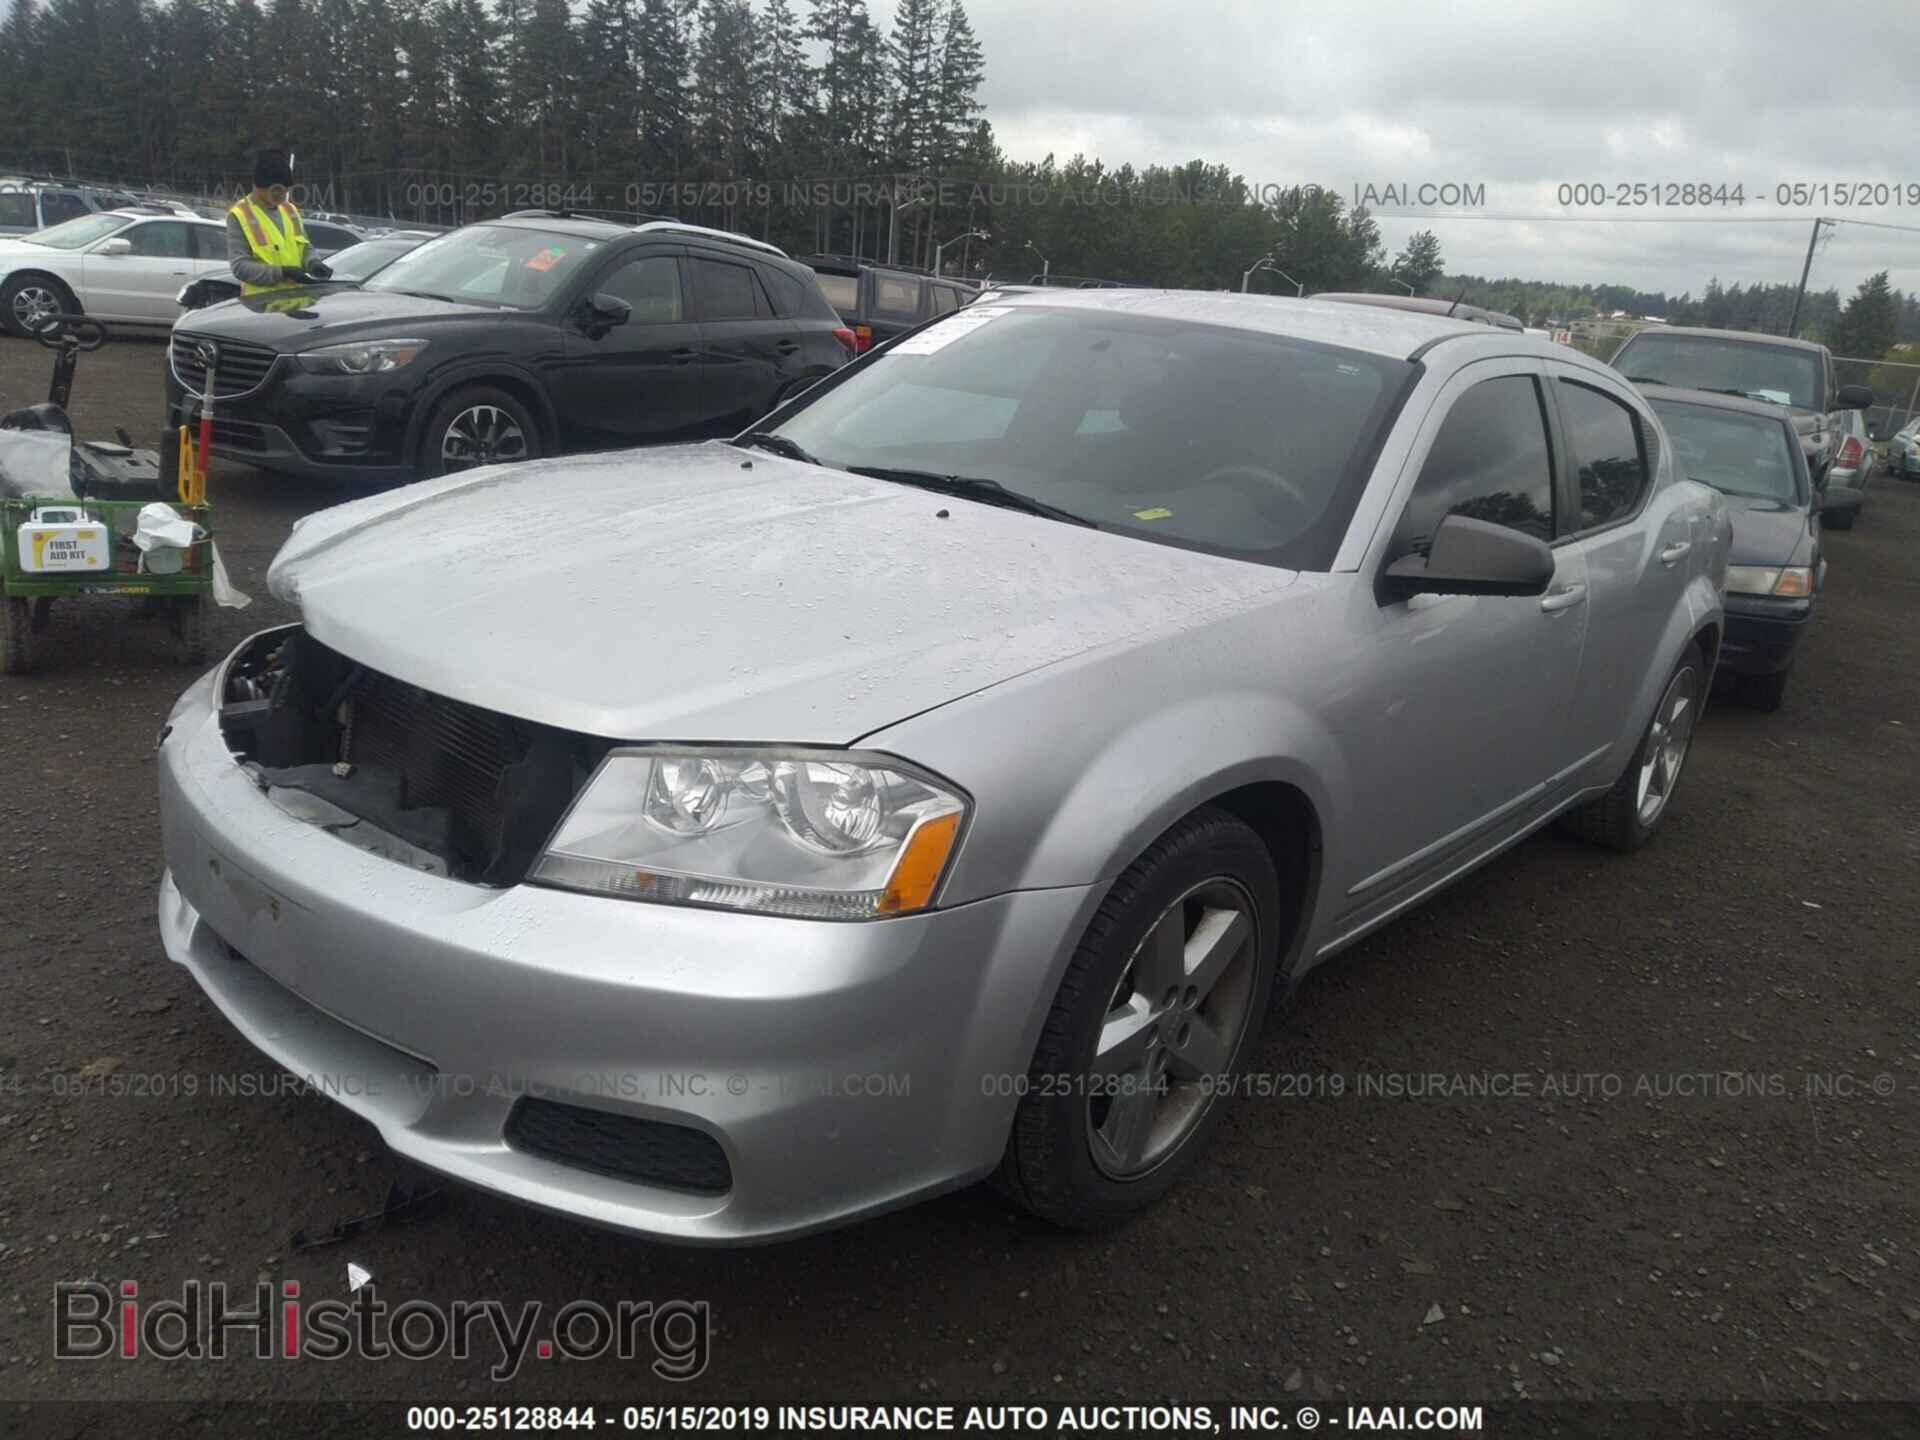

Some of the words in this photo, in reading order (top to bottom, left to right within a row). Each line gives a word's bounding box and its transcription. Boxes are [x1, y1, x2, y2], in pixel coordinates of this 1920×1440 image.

[50, 540, 78, 550] FIRST
[50, 551, 68, 561] AID
[69, 551, 86, 560] KIT
